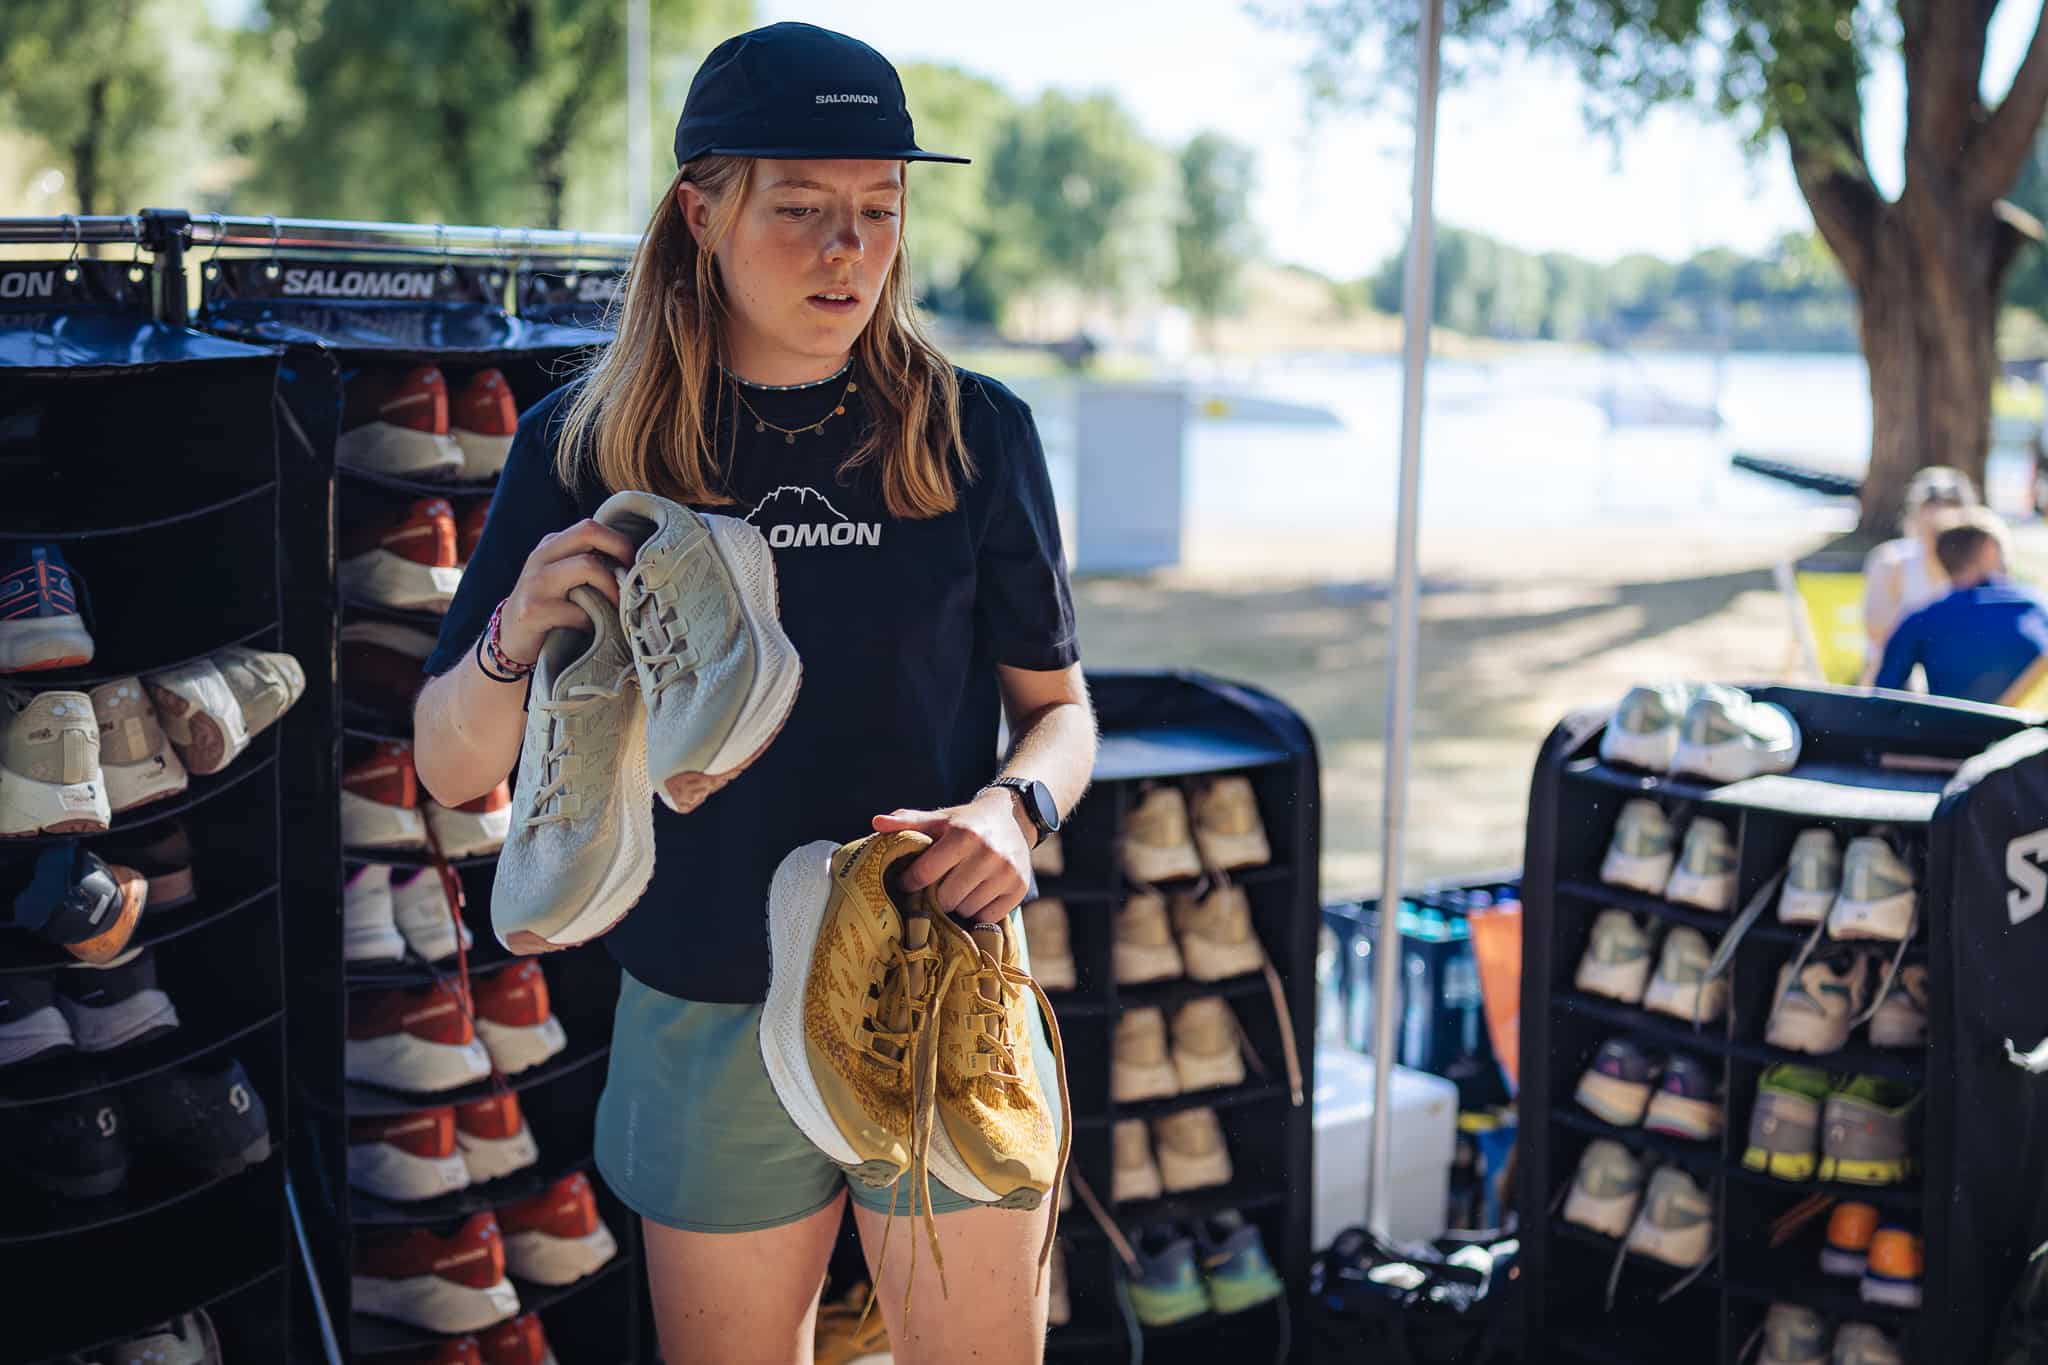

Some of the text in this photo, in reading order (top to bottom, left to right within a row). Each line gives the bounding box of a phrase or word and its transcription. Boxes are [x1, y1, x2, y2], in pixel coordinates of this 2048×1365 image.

[815, 93, 879, 104] SALOMON
[0, 271, 55, 297] ON
[283, 269, 435, 297] SALOMON
[578, 276, 624, 302] SA
[752, 522, 882, 548] OMON
